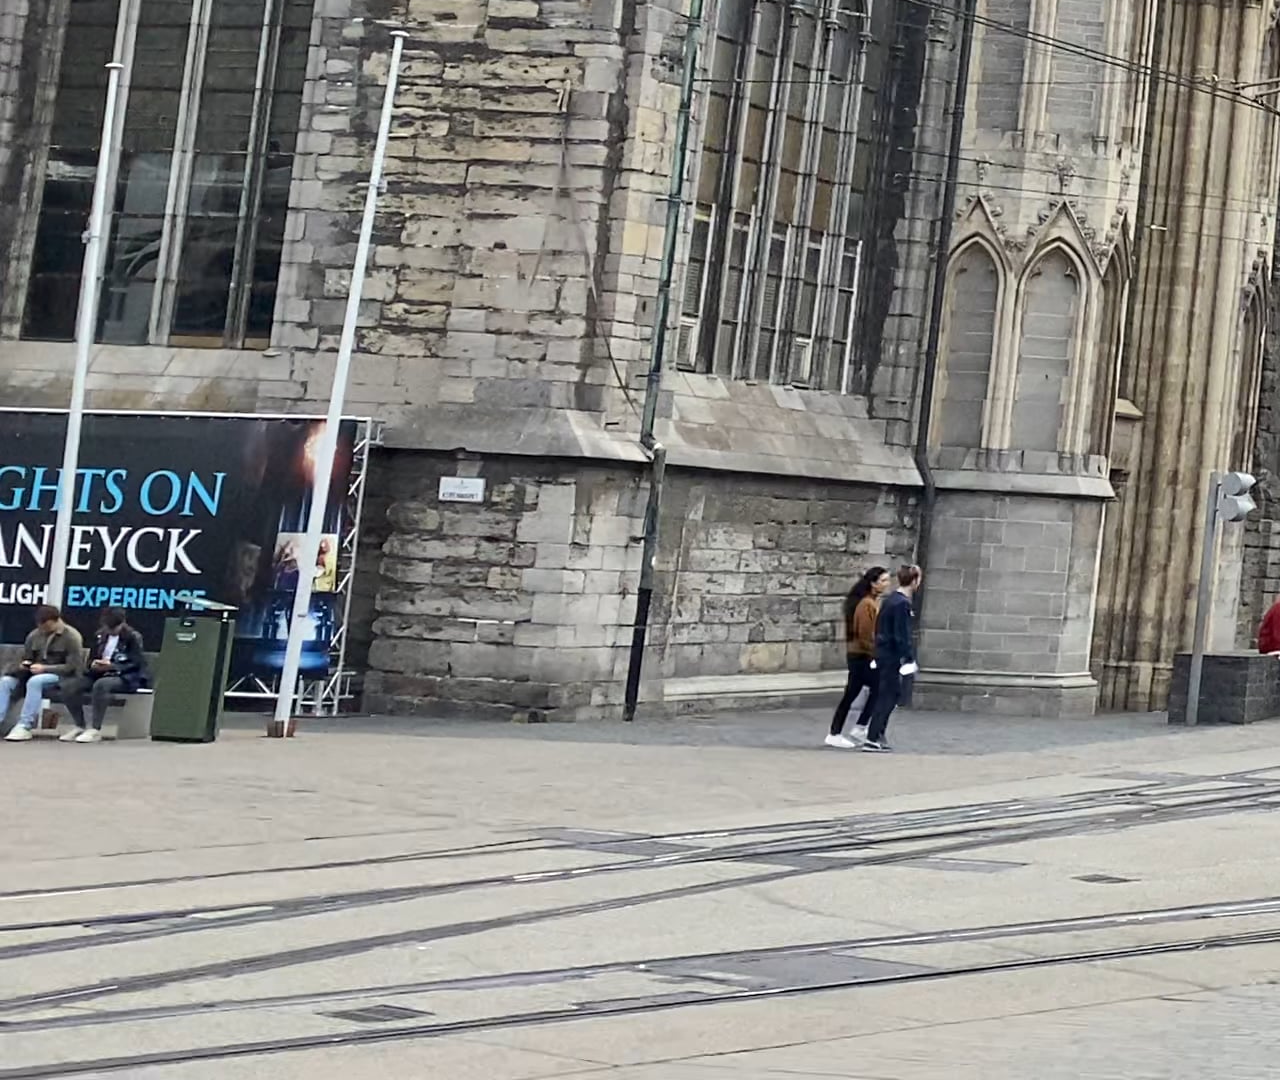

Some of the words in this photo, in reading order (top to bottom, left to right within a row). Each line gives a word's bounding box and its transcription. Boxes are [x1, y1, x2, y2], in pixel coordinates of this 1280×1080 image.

[140, 470, 227, 517] ON
[66, 525, 202, 574] EYCK
[0, 582, 50, 605] LIGH
